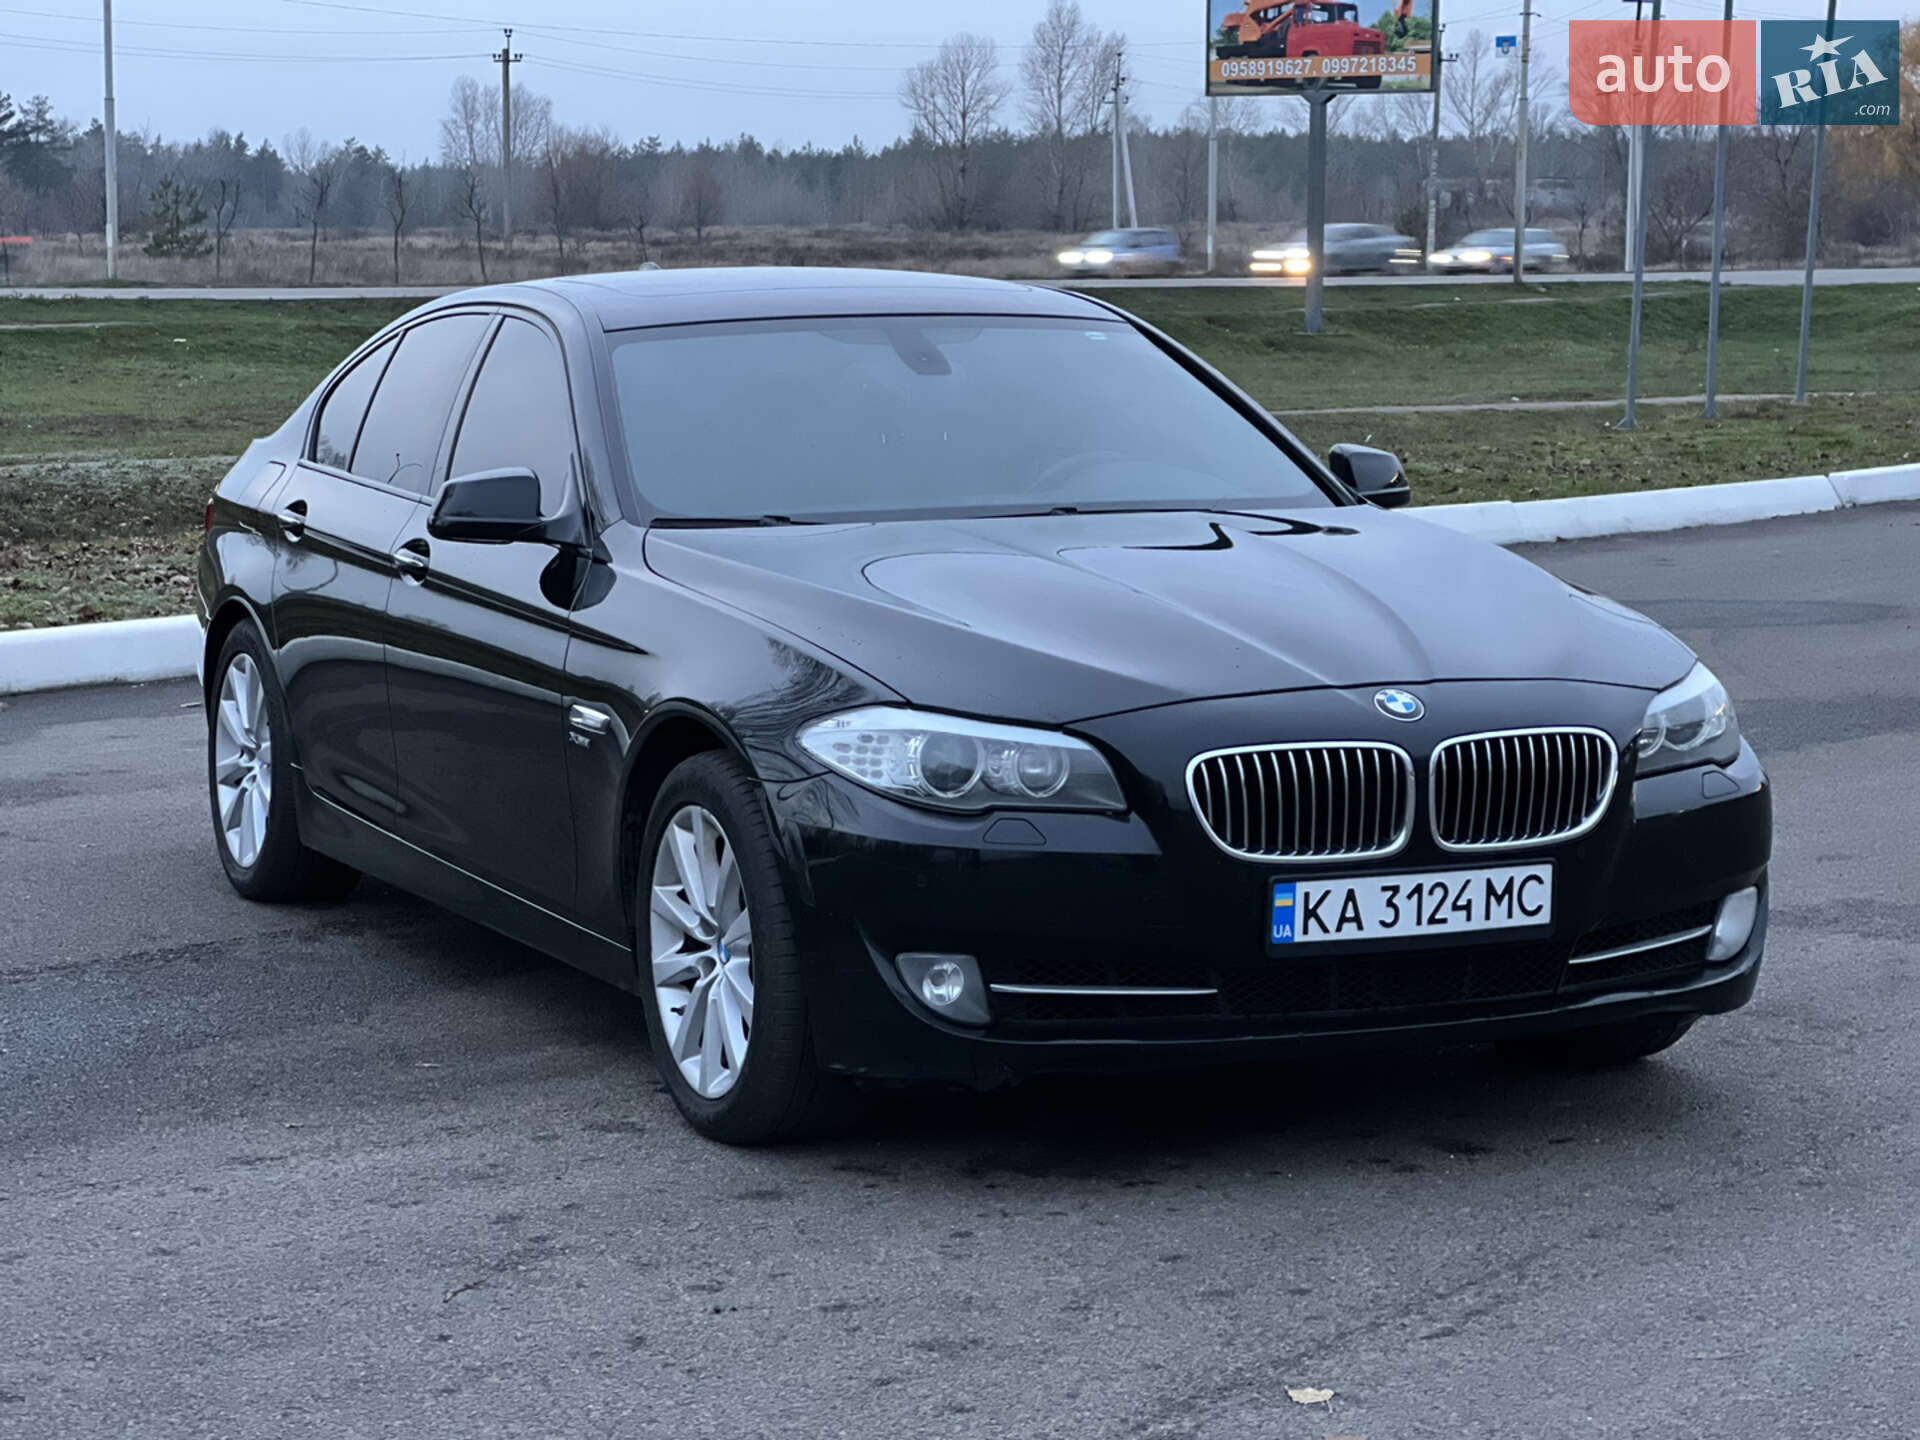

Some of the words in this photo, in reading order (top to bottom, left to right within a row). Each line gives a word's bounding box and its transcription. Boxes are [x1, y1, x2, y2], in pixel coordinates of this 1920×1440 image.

[1322, 56, 1417, 74] 0997218345
[1302, 888, 1364, 936] KA
[1378, 879, 1472, 928] 3124
[1484, 874, 1545, 921] MC
[1273, 924, 1292, 938] UA
